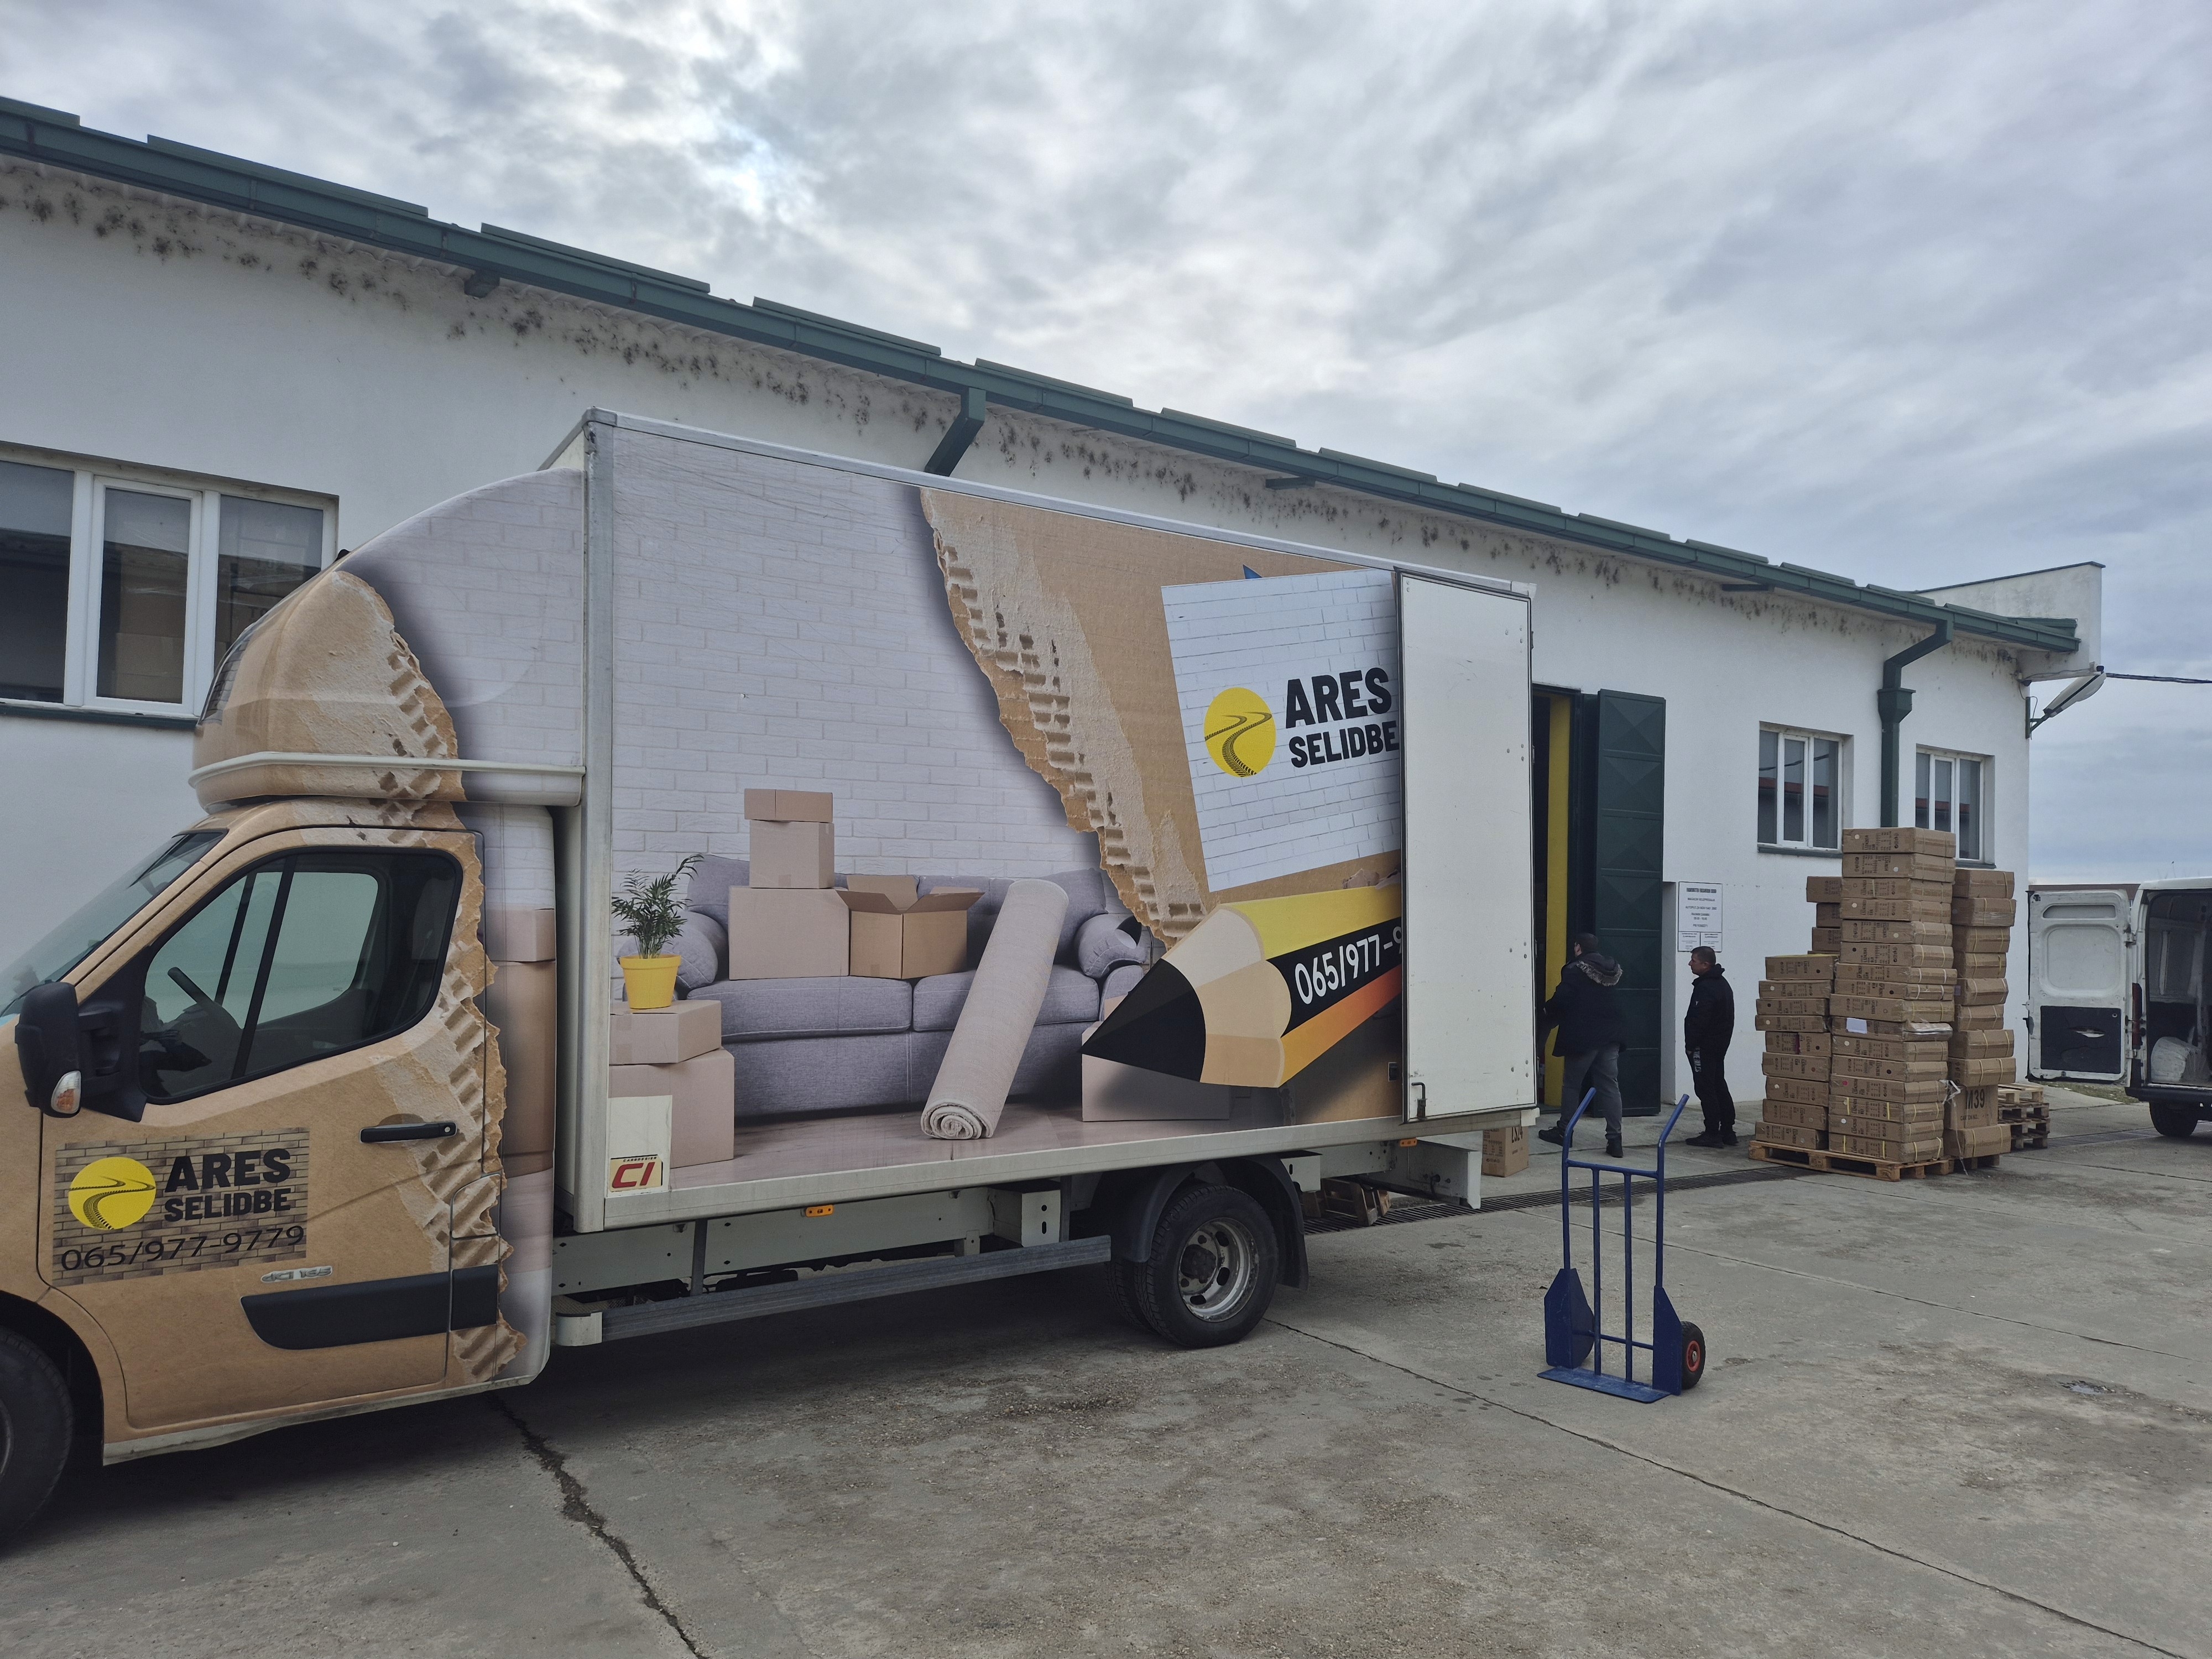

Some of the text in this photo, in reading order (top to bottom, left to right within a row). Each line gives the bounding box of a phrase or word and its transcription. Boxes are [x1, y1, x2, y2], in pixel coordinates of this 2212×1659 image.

[1286, 667, 1392, 728] ARES
[1288, 720, 1400, 768] SELIDBE
[1965, 1088, 1985, 1109] M39
[164, 1149, 291, 1193] ARES
[612, 1162, 655, 1188] CI
[164, 1188, 291, 1222] SELIDBE
[61, 1225, 304, 1271] 065/977-9779
